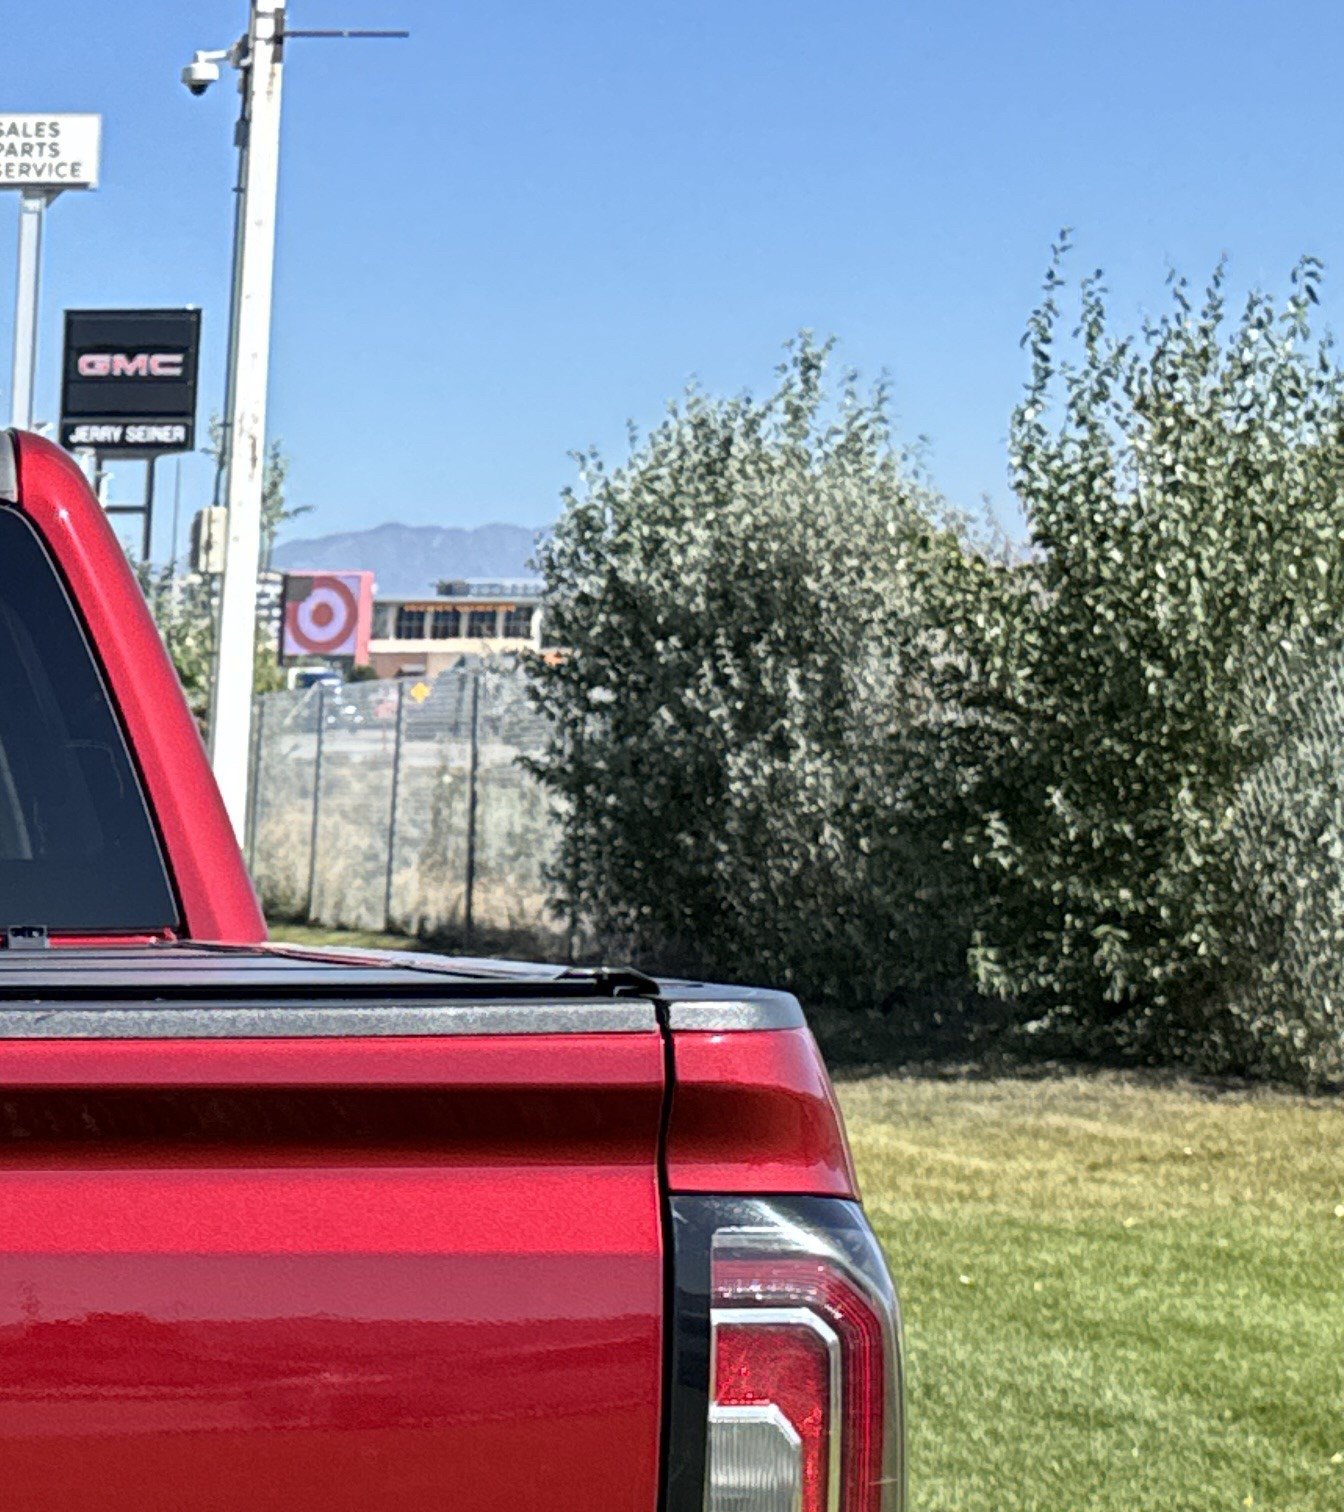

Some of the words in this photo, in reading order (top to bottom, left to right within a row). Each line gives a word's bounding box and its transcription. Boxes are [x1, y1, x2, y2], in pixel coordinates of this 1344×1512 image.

[77, 353, 184, 377] GMC
[69, 425, 123, 443] JERRY
[124, 425, 186, 443] SEINER
